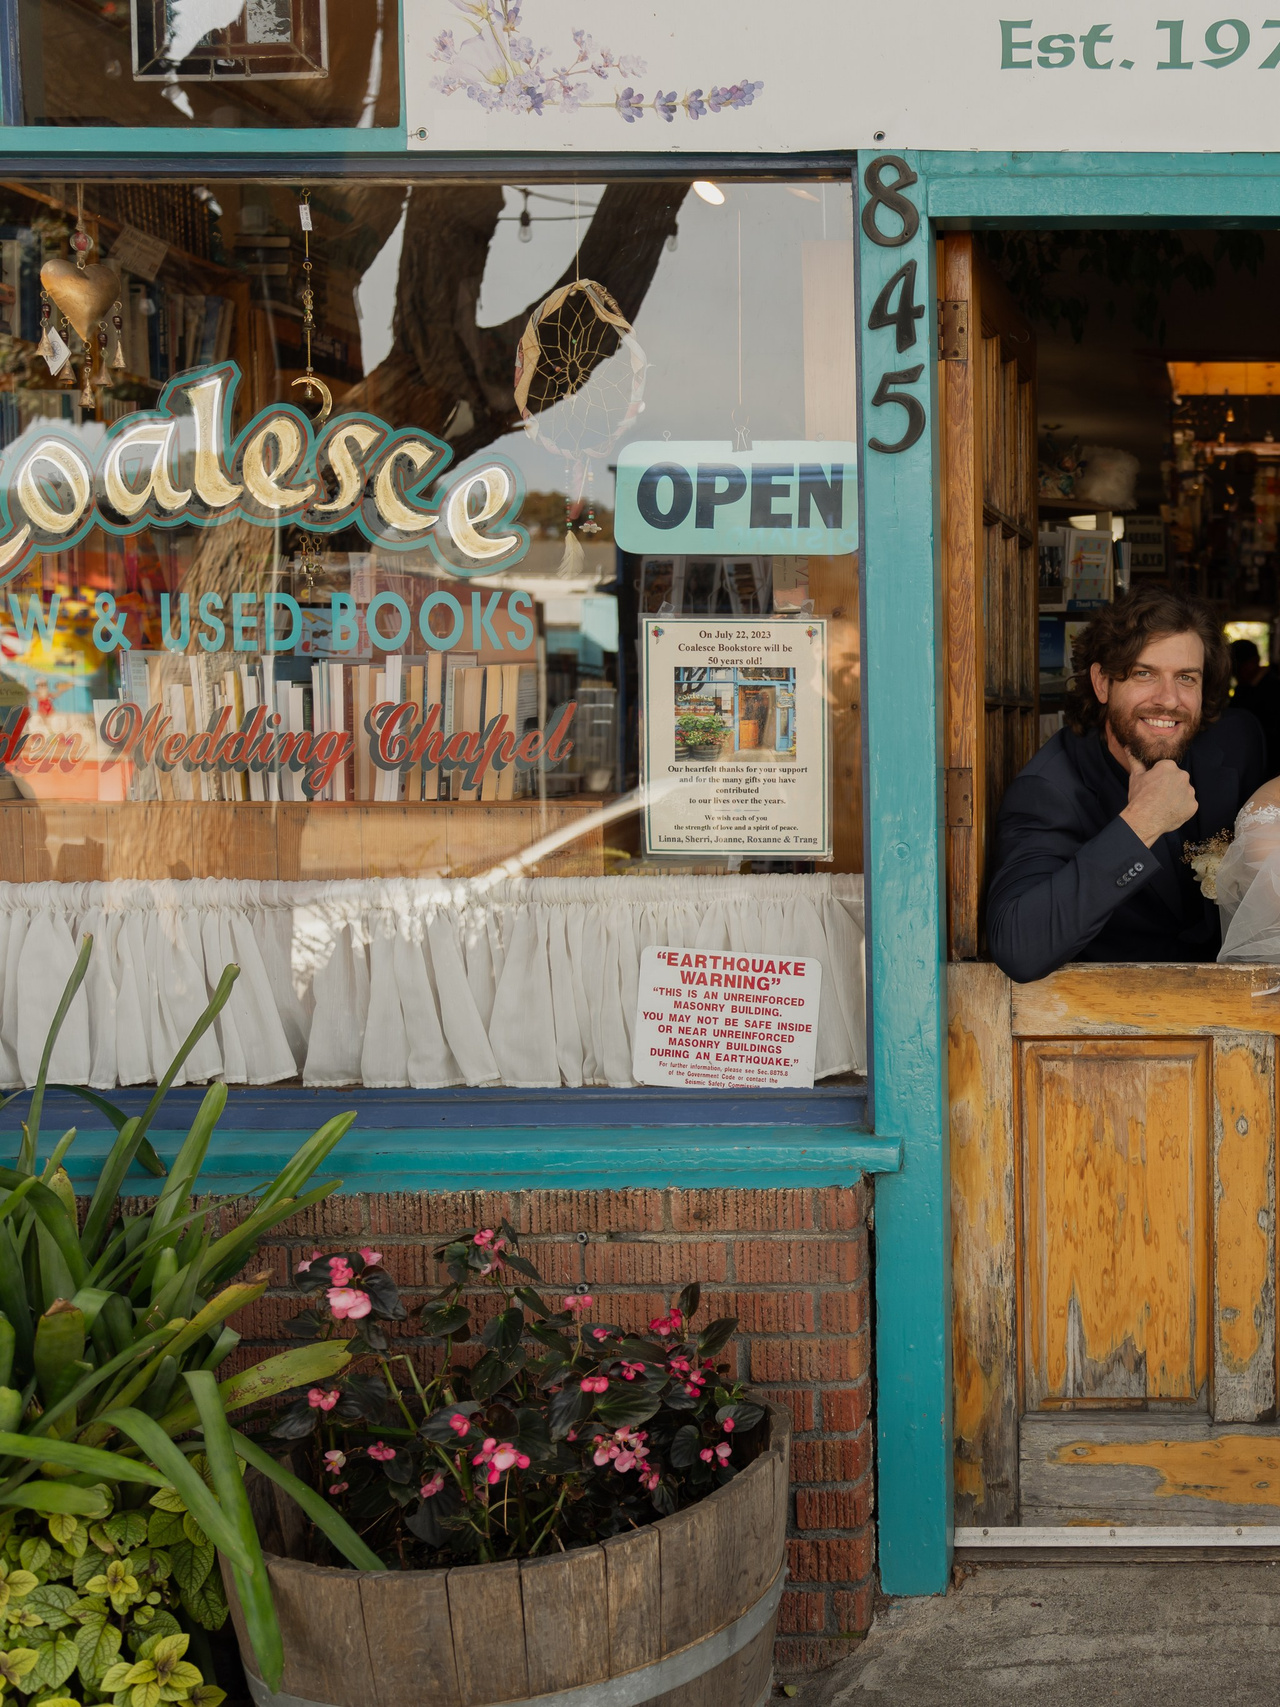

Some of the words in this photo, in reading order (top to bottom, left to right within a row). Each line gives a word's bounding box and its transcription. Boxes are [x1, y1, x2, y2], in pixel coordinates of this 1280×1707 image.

[1000, 18, 1136, 70] Est.
[0, 374, 524, 574] oalesce
[637, 461, 844, 530] OPEN
[93, 592, 131, 652] &
[160, 592, 301, 651] USED
[332, 591, 534, 651] BOOKS
[699, 630, 712, 639] On
[715, 630, 733, 640] July
[735, 630, 749, 640] 22,
[751, 630, 771, 639] 2023
[678, 643, 716, 652] Coalesce
[718, 643, 762, 652] Bookstore
[764, 644, 780, 652] will
[782, 644, 793, 652] be
[708, 657, 719, 665] 50
[720, 658, 743, 666] years
[746, 657, 763, 665] old!
[100, 702, 355, 797] Wedding
[364, 699, 577, 791] Chapel
[667, 765, 684, 773] Our
[685, 765, 717, 773] heartfelt
[718, 765, 744, 773] thanks
[746, 765, 757, 773] for
[759, 766, 777, 774] your
[779, 766, 808, 774] support
[658, 835, 683, 844] Linna,
[685, 835, 712, 844] Sherri,
[714, 835, 745, 844] Joanne,
[747, 835, 781, 844] Roxanne
[794, 835, 818, 845] Trang
[688, 989, 698, 998] IS
[703, 991, 718, 1000] AN
[723, 992, 805, 1007] UNREINFORCED
[673, 1000, 725, 1013] MASONRY
[731, 1004, 783, 1017] BUILDING.
[643, 1011, 664, 1021] YOU
[668, 1013, 691, 1023] MAY
[697, 1016, 719, 1025] NOT
[725, 1018, 739, 1027] BE
[744, 1019, 772, 1030] SAFE
[777, 1022, 812, 1033] INSIDE
[658, 1024, 673, 1034] OR
[678, 1026, 707, 1037] NEAR
[712, 1029, 795, 1044] UNREINFORCED
[650, 1047, 690, 1059] DURING
[695, 1051, 710, 1060] AN
[668, 1037, 720, 1049] MASONRY
[726, 1041, 782, 1054] BUILDINGS
